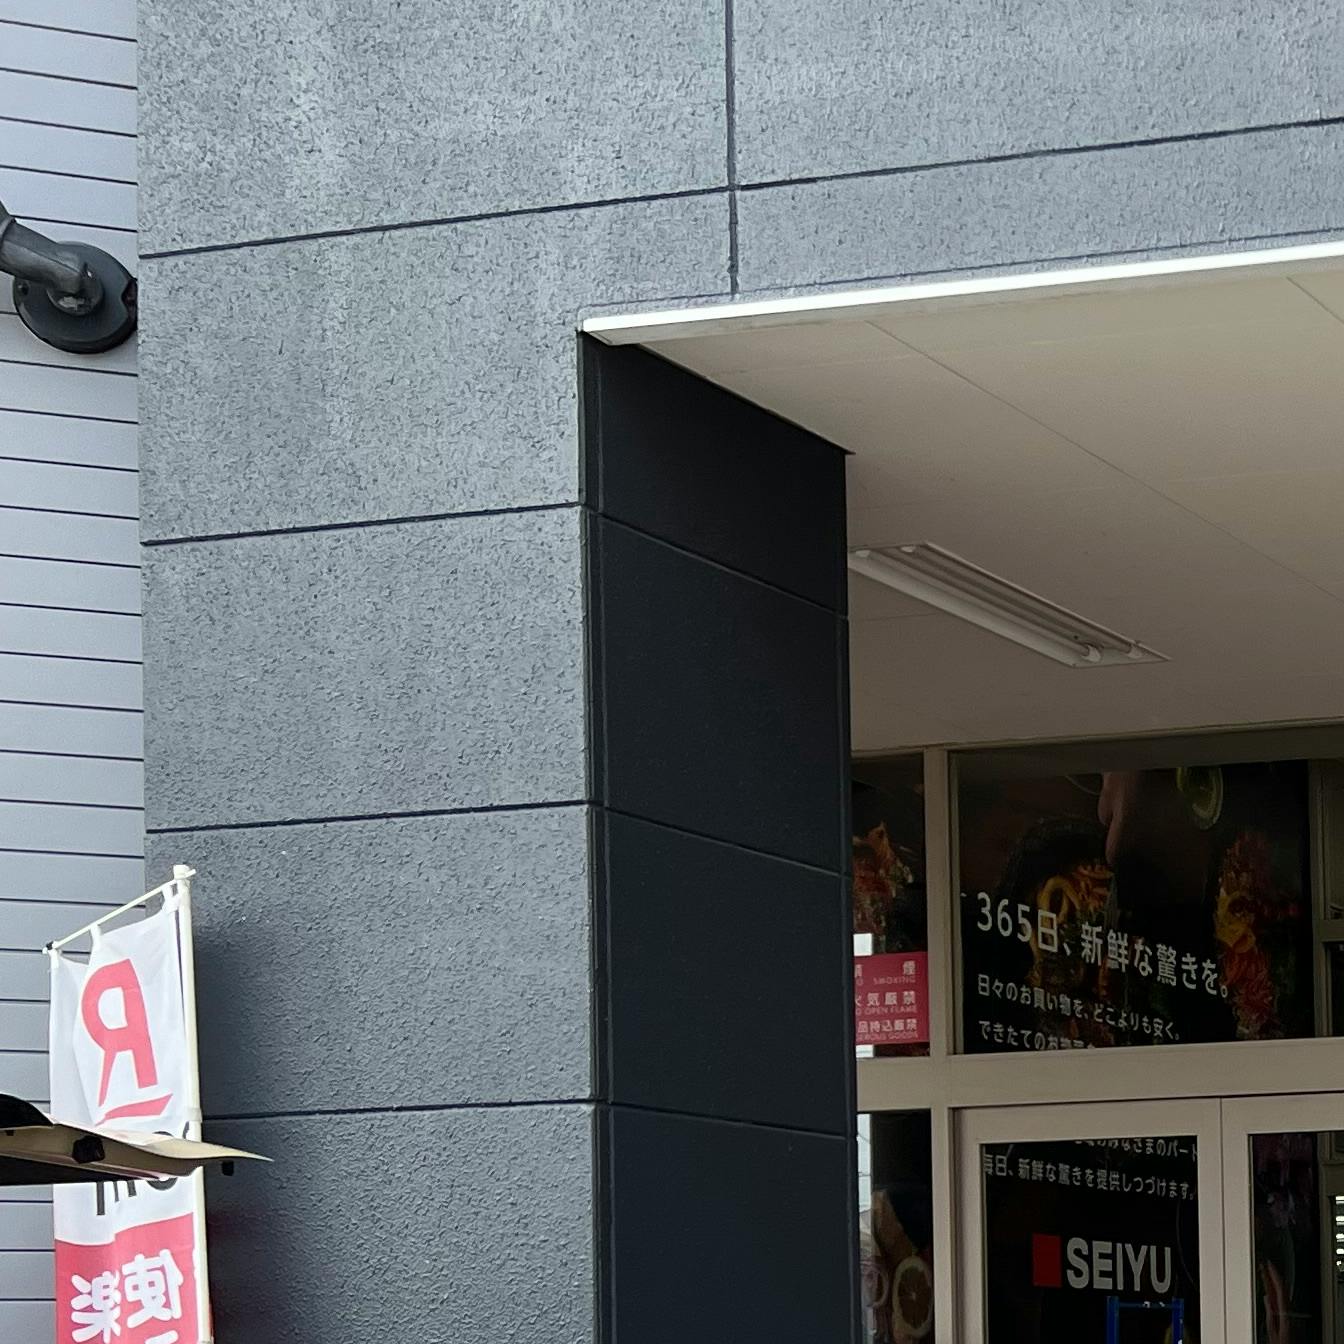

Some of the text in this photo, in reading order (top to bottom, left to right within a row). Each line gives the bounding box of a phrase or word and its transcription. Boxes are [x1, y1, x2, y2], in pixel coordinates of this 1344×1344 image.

[977, 891, 1228, 999] 365日、新鮮な驚きを。
[1066, 1236, 1172, 1294] SEIYU
